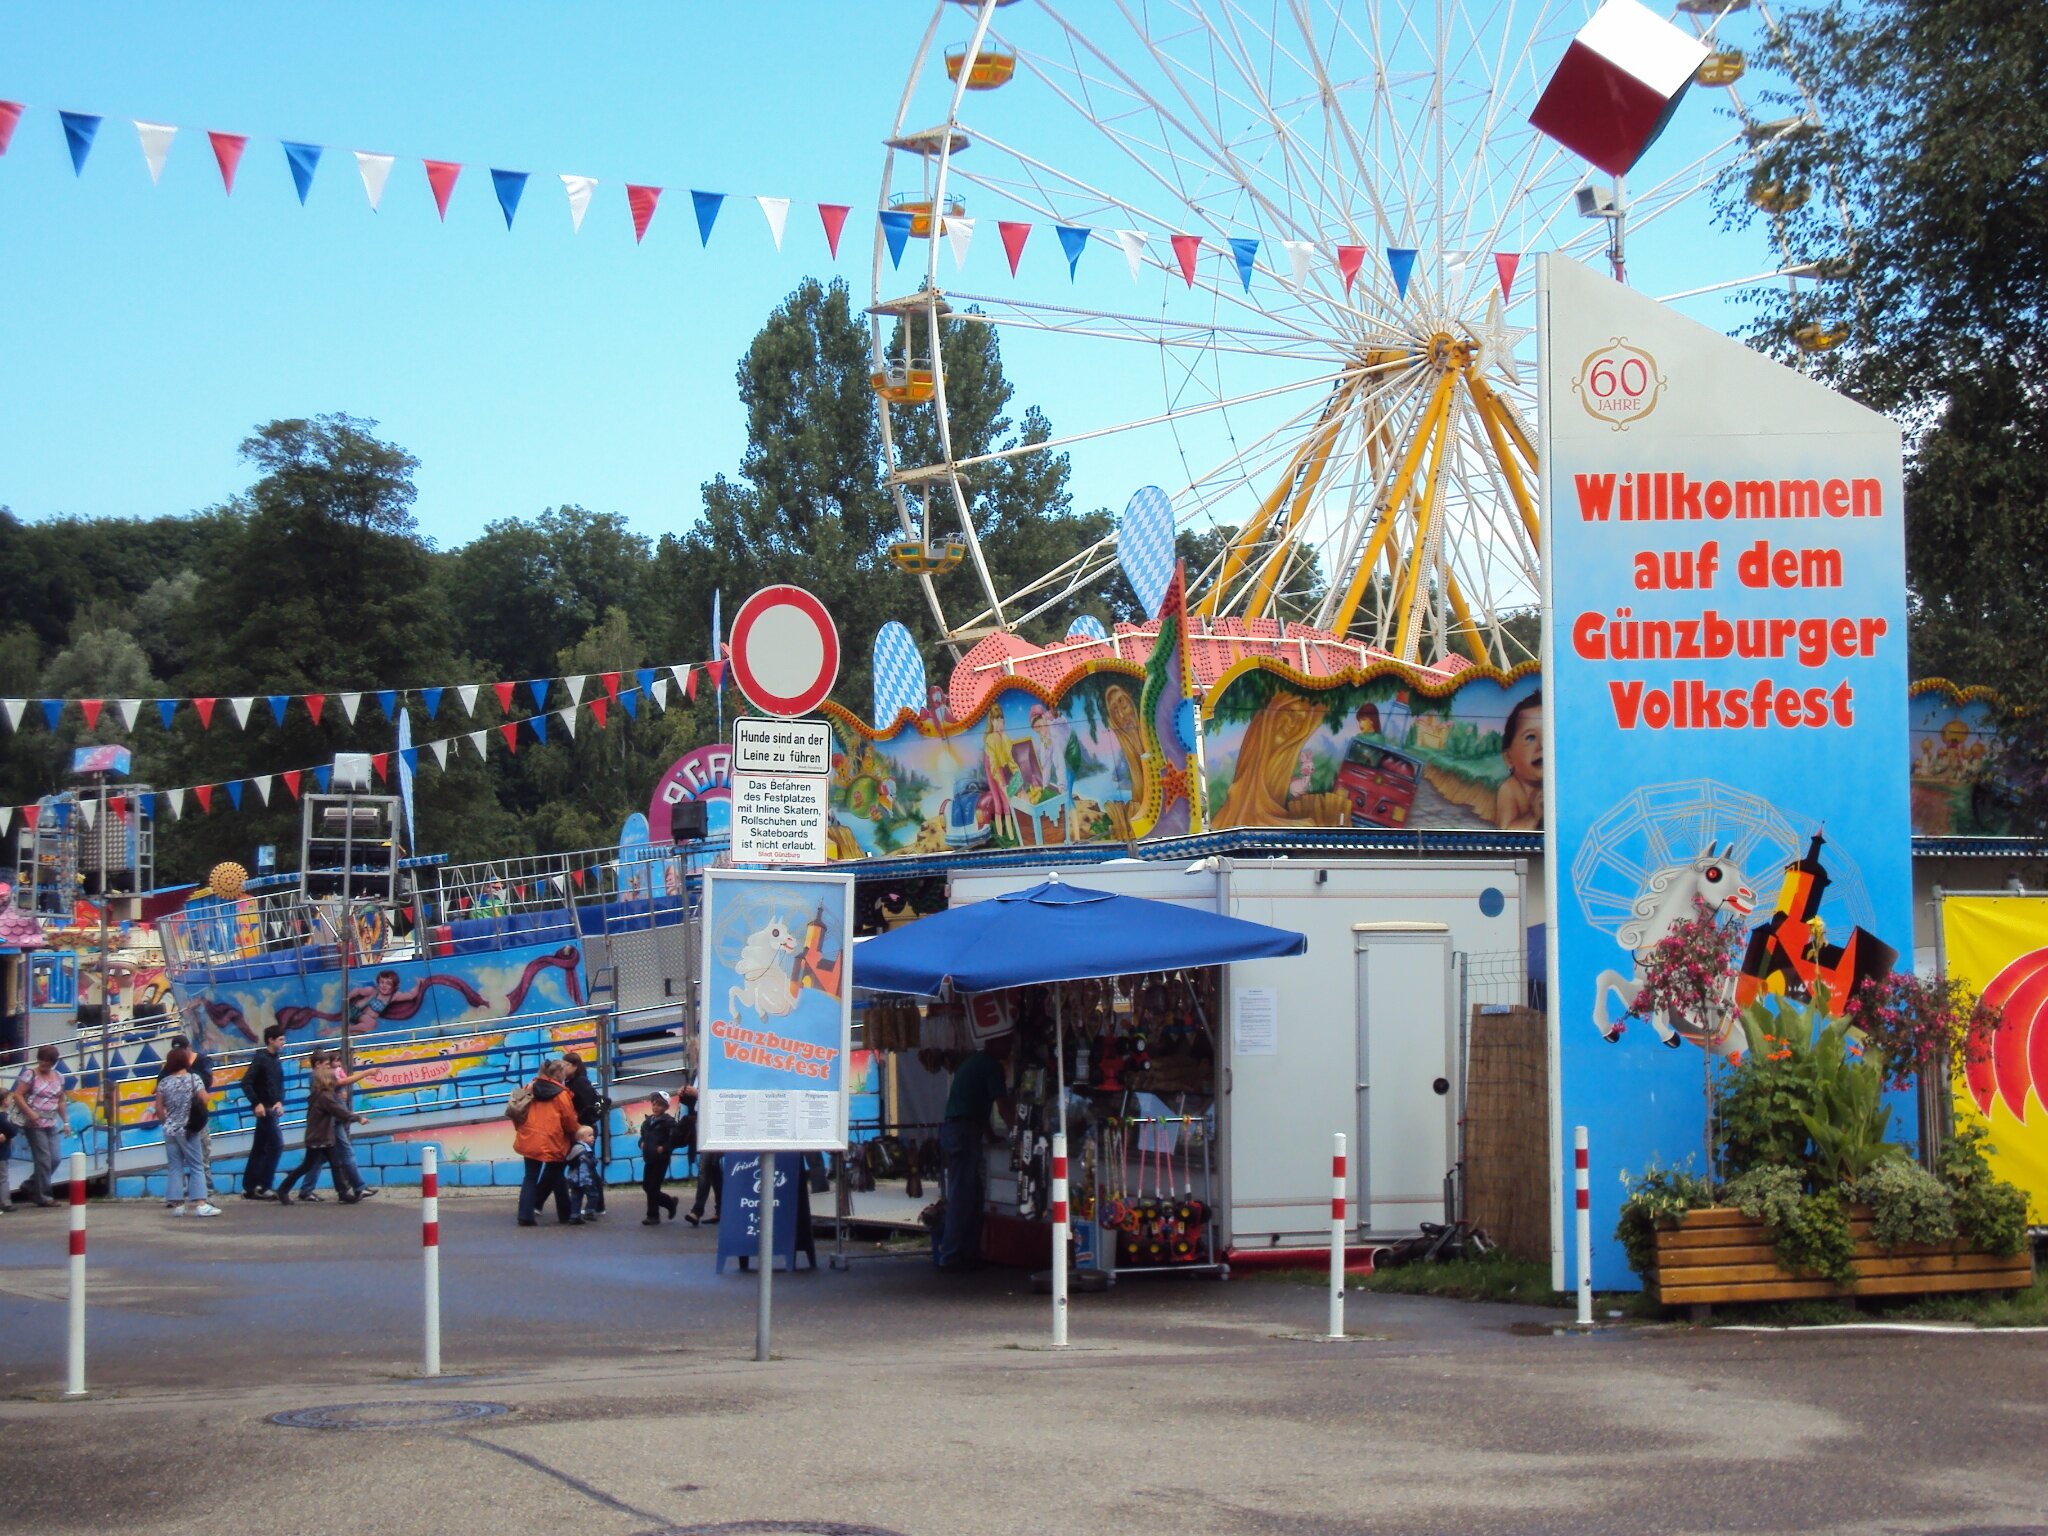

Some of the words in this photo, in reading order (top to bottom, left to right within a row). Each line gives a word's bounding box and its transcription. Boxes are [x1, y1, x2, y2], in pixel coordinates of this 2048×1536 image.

[1590, 358, 1647, 397] 60
[1598, 399, 1641, 411] JAHRE
[1574, 472, 1883, 522] Willkommen
[1634, 540, 1719, 590] auf
[1738, 540, 1842, 589] dem
[1572, 607, 1887, 668] Günzburger
[1608, 677, 1854, 730] Volksfest
[740, 730, 770, 744] Hunde
[773, 732, 792, 744] sind
[794, 735, 805, 745] an
[808, 733, 824, 746] der
[743, 748, 770, 761] Leine
[773, 752, 785, 762] zu
[790, 751, 821, 763] führen
[748, 780, 767, 790] Das
[770, 781, 811, 792] Befahren
[744, 792, 761, 801] des
[764, 793, 816, 804] Festplatzes
[737, 804, 752, 813] mit
[756, 804, 780, 814] Inline
[784, 806, 821, 816] Skatern,
[741, 816, 797, 827] Rollschuhen
[800, 817, 818, 827] und
[750, 828, 809, 838] Skateboards
[741, 840, 752, 849] ist
[756, 840, 778, 850] nicht
[782, 841, 816, 851] erlaubt.
[758, 850, 772, 858] Stadt
[774, 851, 801, 859] Günzburg
[711, 1020, 839, 1062] Günzburger
[723, 1040, 831, 1081] Volksfest
